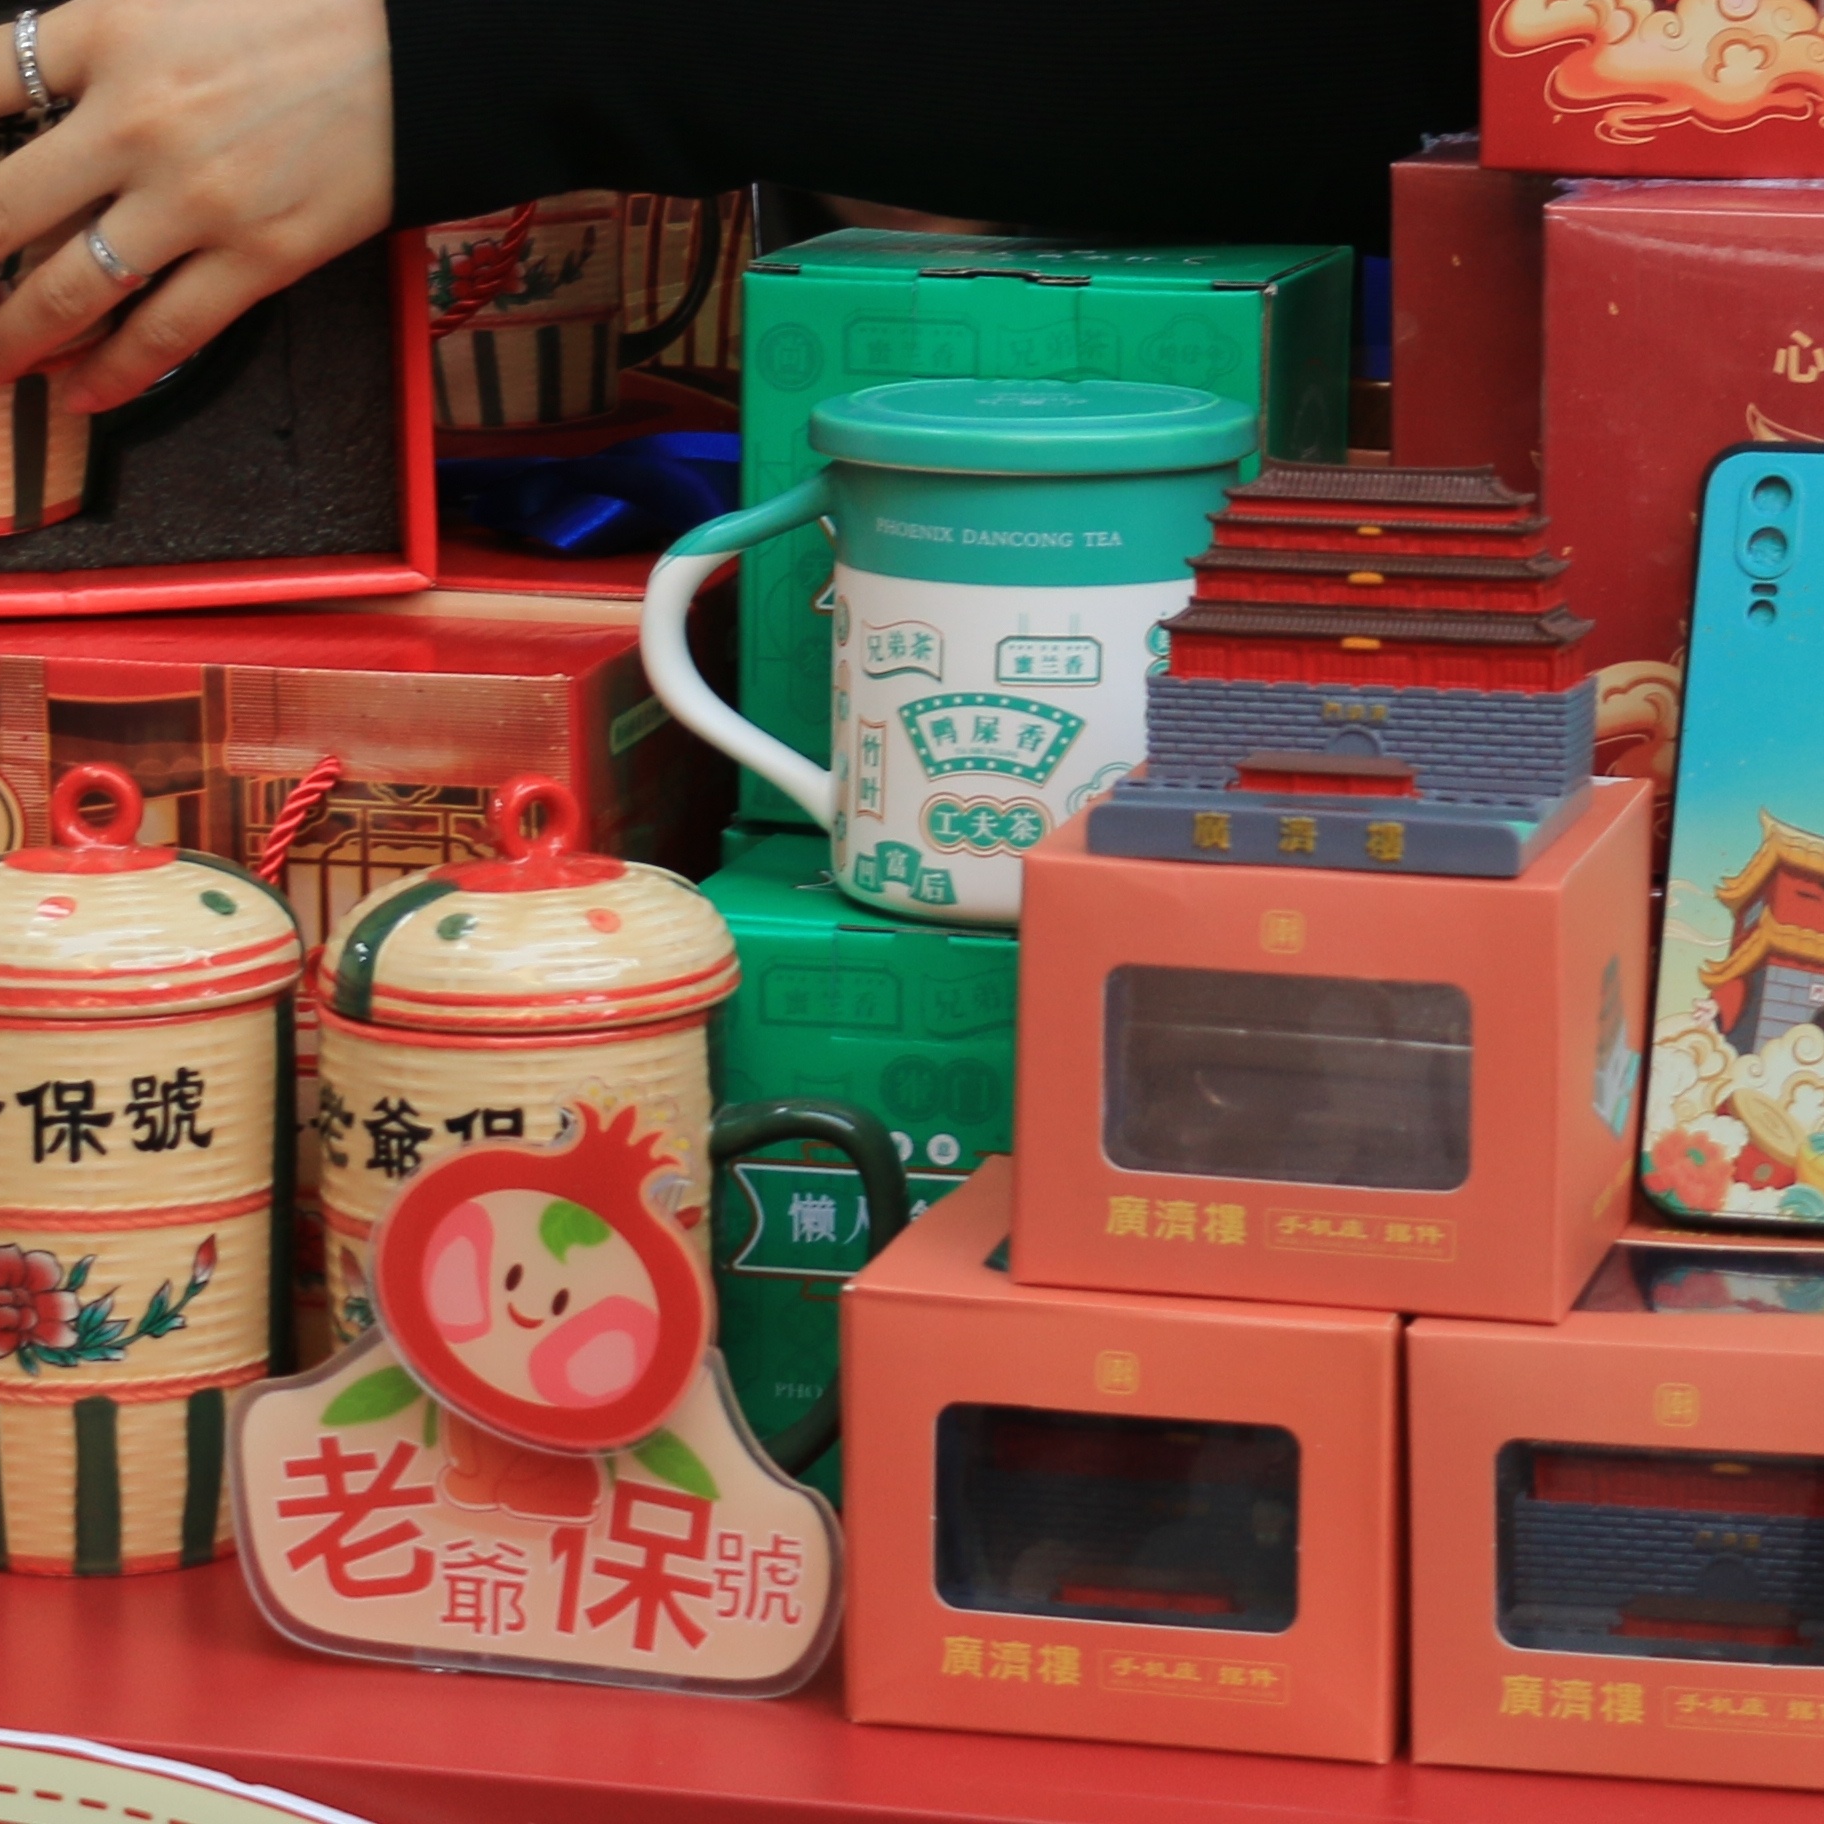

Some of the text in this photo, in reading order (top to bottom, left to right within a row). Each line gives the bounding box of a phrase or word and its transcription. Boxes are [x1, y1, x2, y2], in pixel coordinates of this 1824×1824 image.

[876, 516, 1124, 549] PHOENIX DANCONG TEA
[934, 809, 1040, 842] 工夫茶
[276, 1434, 804, 1653] 老爺保號
